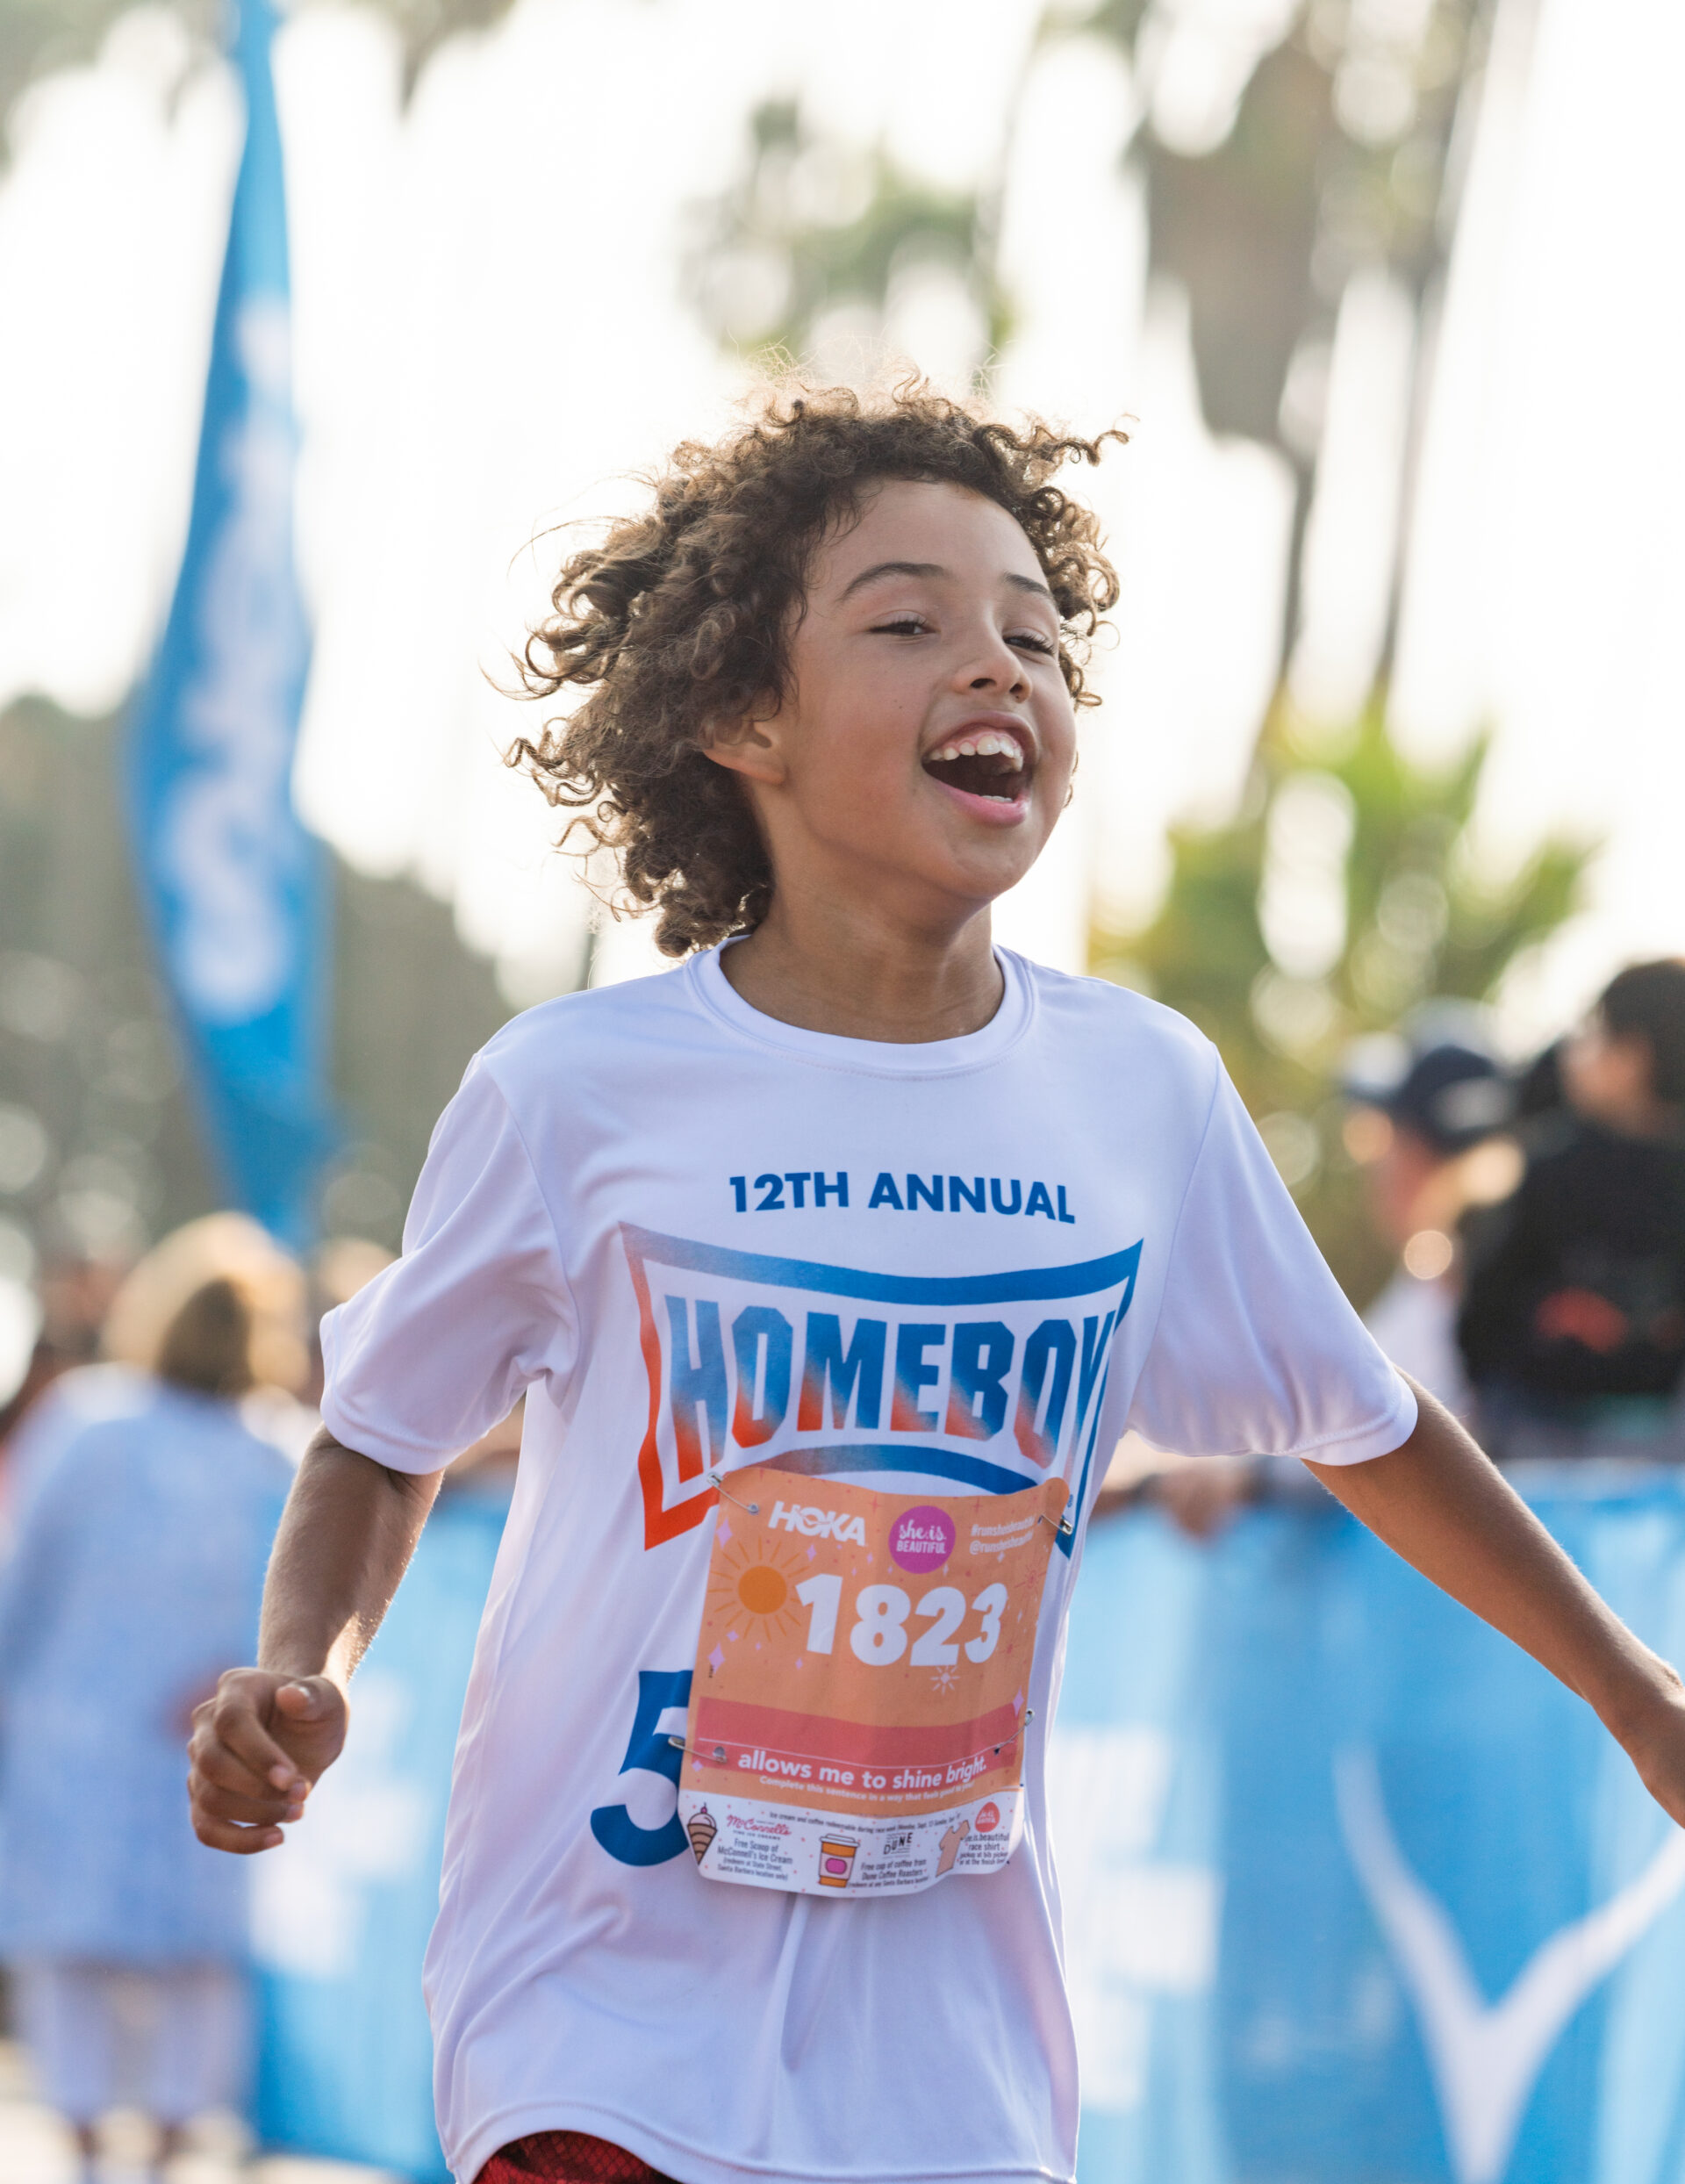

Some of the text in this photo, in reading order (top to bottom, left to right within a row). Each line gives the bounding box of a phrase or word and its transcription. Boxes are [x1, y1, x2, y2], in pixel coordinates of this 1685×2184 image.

[729, 1171, 1075, 1224] 12TH ANNUAL
[664, 1295, 1116, 1484] HOMEBOY
[768, 1500, 866, 1547] HOKA
[896, 1541, 947, 1554] BEAUTIFUL
[796, 1573, 1007, 1666] 1823
[738, 1749, 987, 1789] allows me to shine bright.
[759, 1774, 804, 1790] Complete
[807, 1783, 824, 1793] this
[826, 1787, 867, 1801] sentence
[887, 1793, 903, 1804] way
[906, 1792, 921, 1801] that
[717, 1845, 793, 1864] McConnell's Ice Cream
[734, 1838, 749, 1849] Free
[749, 1840, 770, 1852] Scoop
[883, 1832, 914, 1856] DUNE
[984, 1843, 1000, 1851] shirt
[861, 1862, 875, 1871] Free
[876, 1863, 886, 1871] cup
[894, 1859, 913, 1869] coffee
[914, 1858, 928, 1867] from
[862, 1868, 924, 1881] Dune Coffee Roasters
